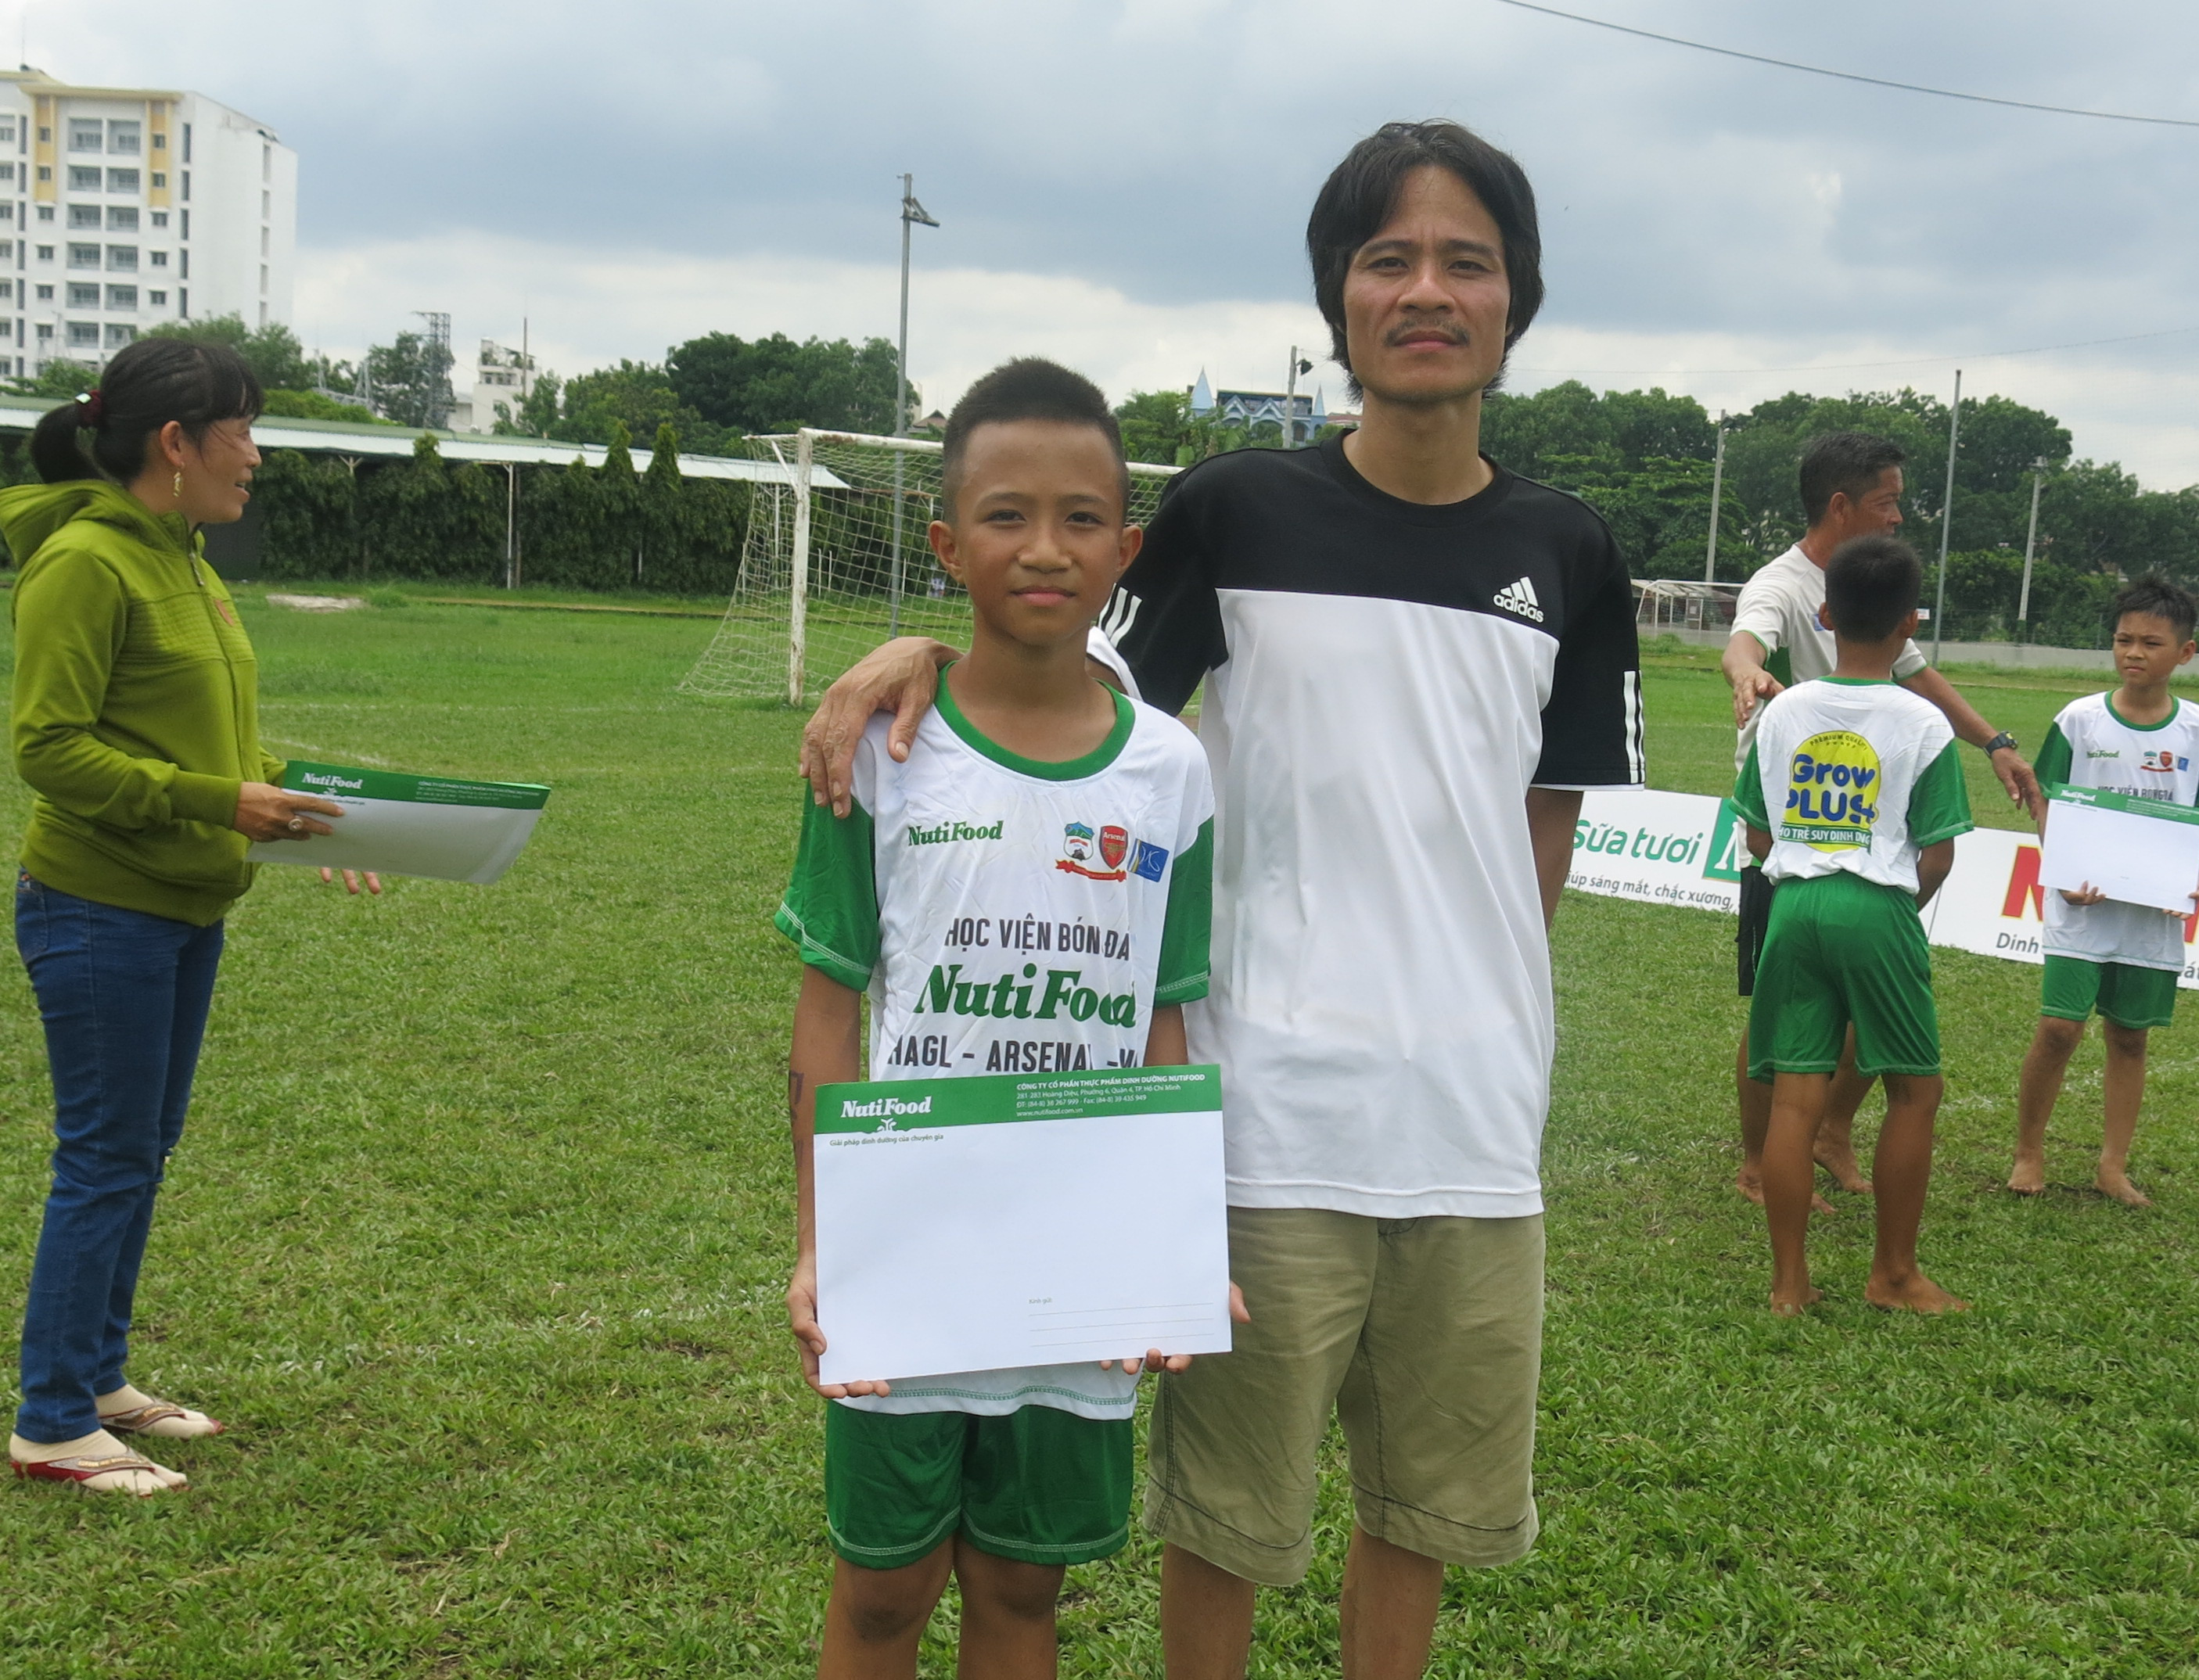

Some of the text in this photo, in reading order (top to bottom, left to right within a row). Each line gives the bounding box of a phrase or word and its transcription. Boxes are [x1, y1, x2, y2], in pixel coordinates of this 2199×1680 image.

[1493, 594, 1543, 623] adidas
[1809, 734, 1843, 746] PREMIUM
[302, 772, 363, 789] NutiFood
[1793, 754, 1875, 788] Grow
[908, 820, 1004, 846] NutiFood
[1103, 831, 1126, 842] Arsenal
[1572, 820, 1628, 856] Sữa
[1630, 827, 1704, 865] tươi
[1811, 831, 1829, 840] SUY
[1566, 871, 1734, 910] iúp sáng mắt, chắc xương,
[944, 917, 990, 953] HỌC
[999, 913, 1051, 955] VIỆN
[1996, 932, 2039, 953] Dinh
[913, 963, 1136, 1028] NutiFood
[887, 1035, 952, 1068] HAGL
[986, 1040, 1094, 1072] ARSENA
[1016, 1082, 1037, 1090] CÔNG
[840, 1096, 932, 1118] NutiFood
